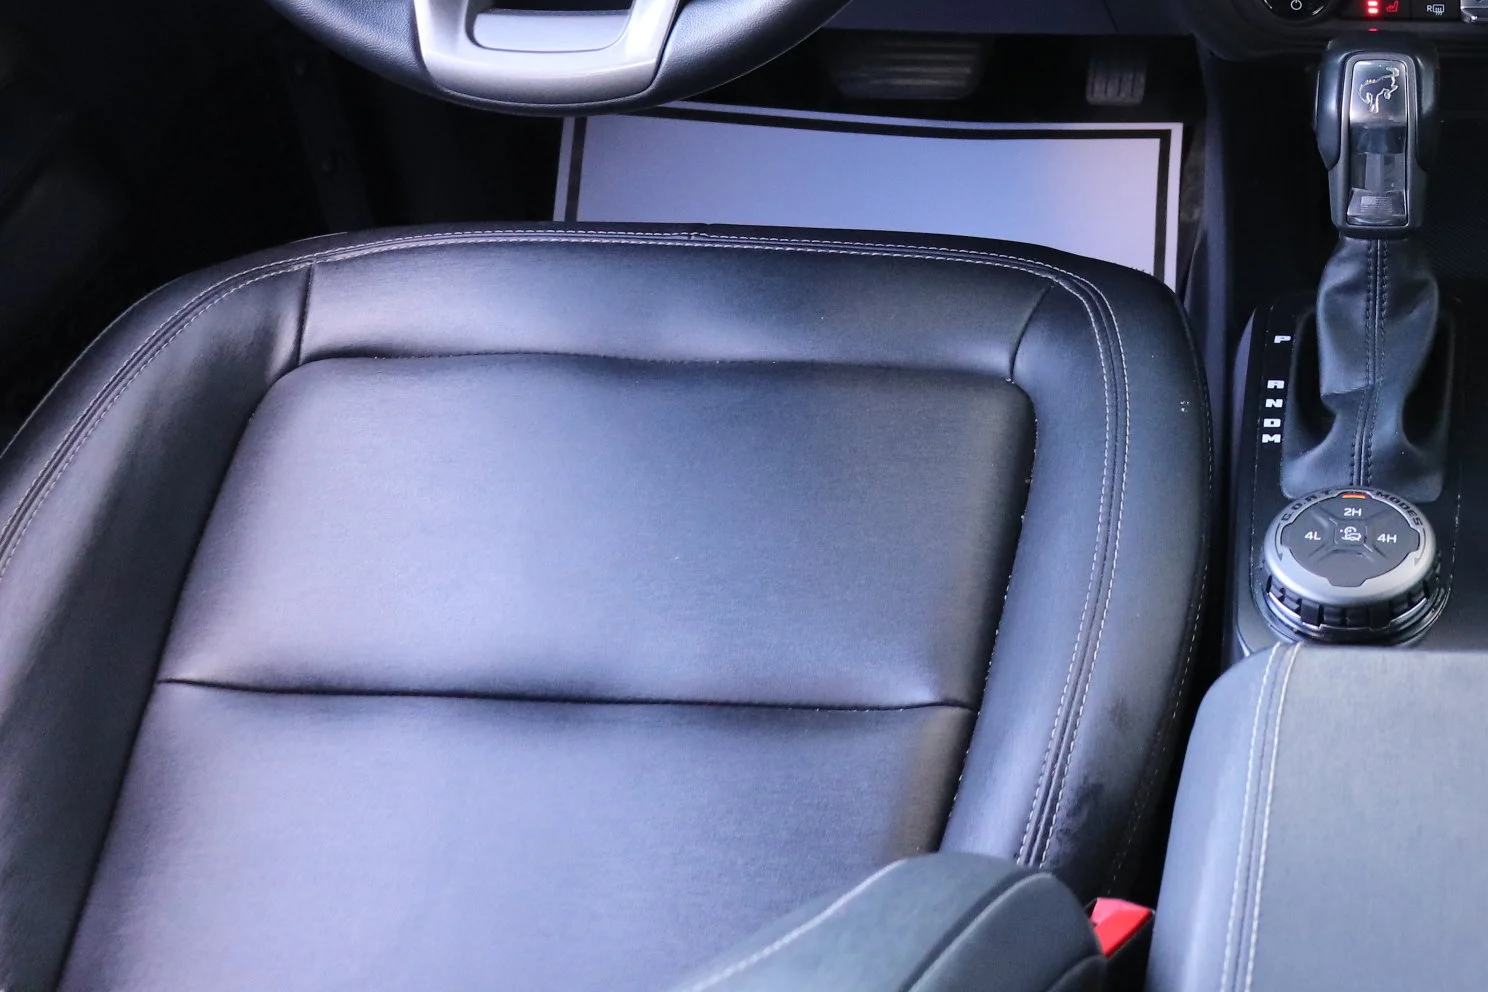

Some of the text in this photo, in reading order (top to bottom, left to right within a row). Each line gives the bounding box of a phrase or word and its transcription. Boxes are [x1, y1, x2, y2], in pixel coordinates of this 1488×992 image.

[1273, 335, 1291, 344] P
[1265, 398, 1284, 408] N
[1263, 418, 1281, 428] D
[1261, 433, 1282, 443] M
[1343, 507, 1362, 517] 2H
[1376, 490, 1423, 526] MODES
[1304, 531, 1322, 541] 4L
[1376, 533, 1397, 543] 4H
